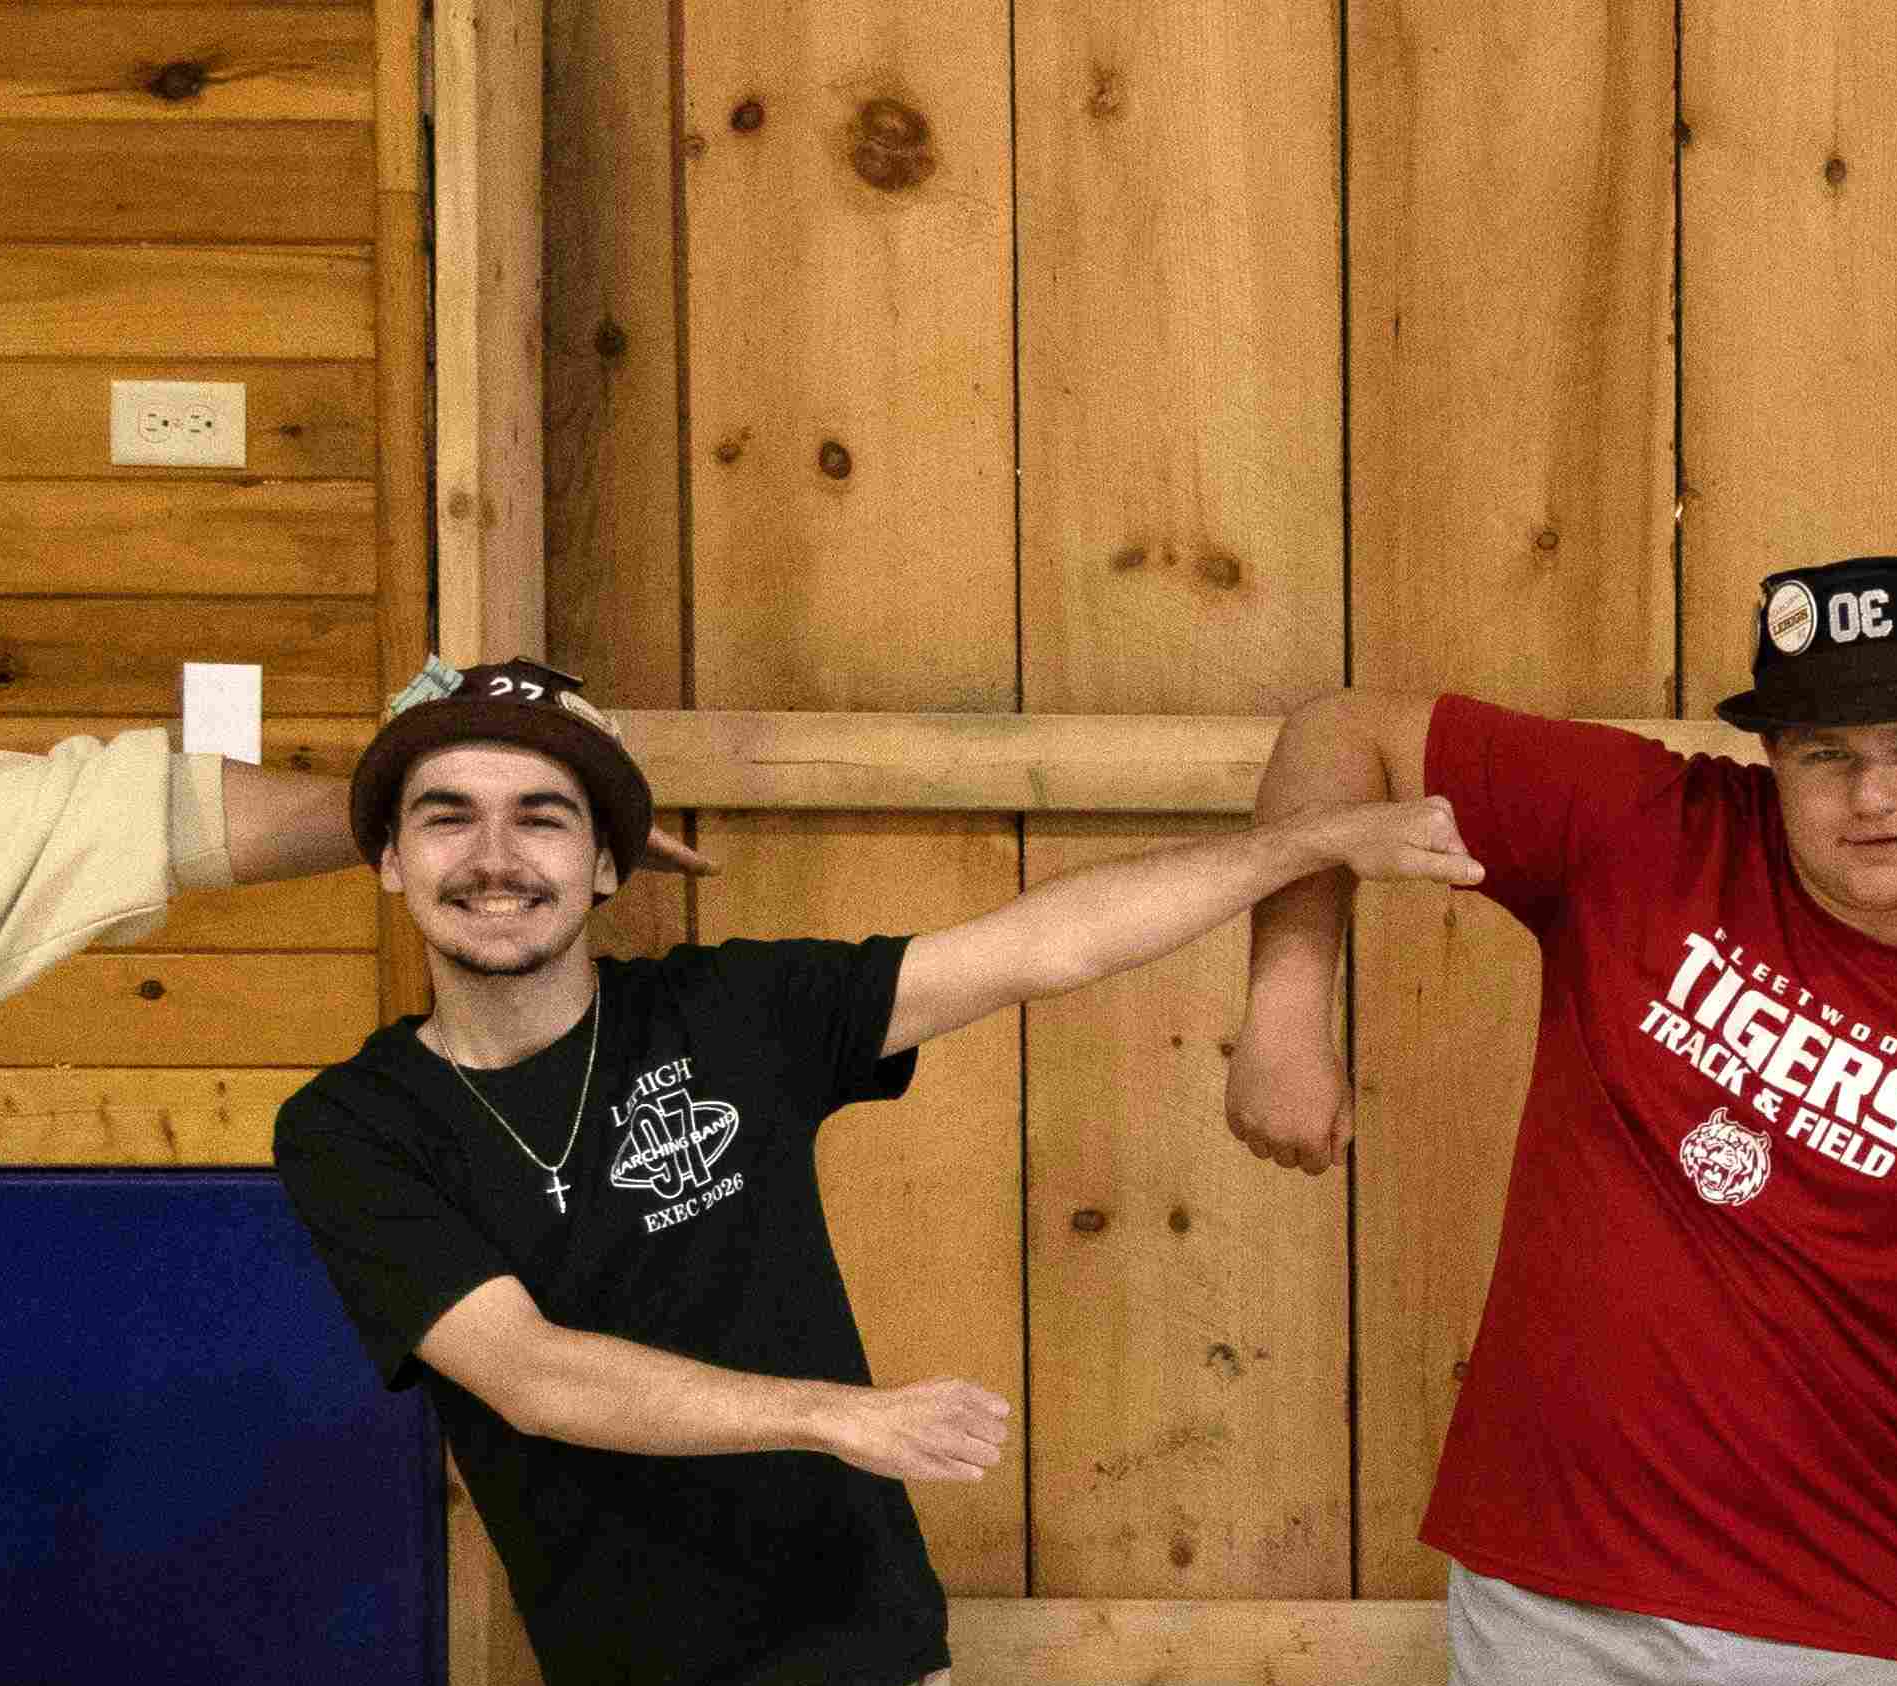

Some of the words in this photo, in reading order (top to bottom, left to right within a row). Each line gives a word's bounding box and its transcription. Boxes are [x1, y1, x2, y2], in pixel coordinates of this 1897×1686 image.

[690, 1111, 736, 1144] BAND
[1639, 1000, 1753, 1097] TRACK
[1752, 1087, 1784, 1124] &
[1786, 1106, 1896, 1179] FIELD
[631, 1088, 711, 1199] 97
[644, 1198, 700, 1233] EXEC
[702, 1172, 744, 1210] 2026
